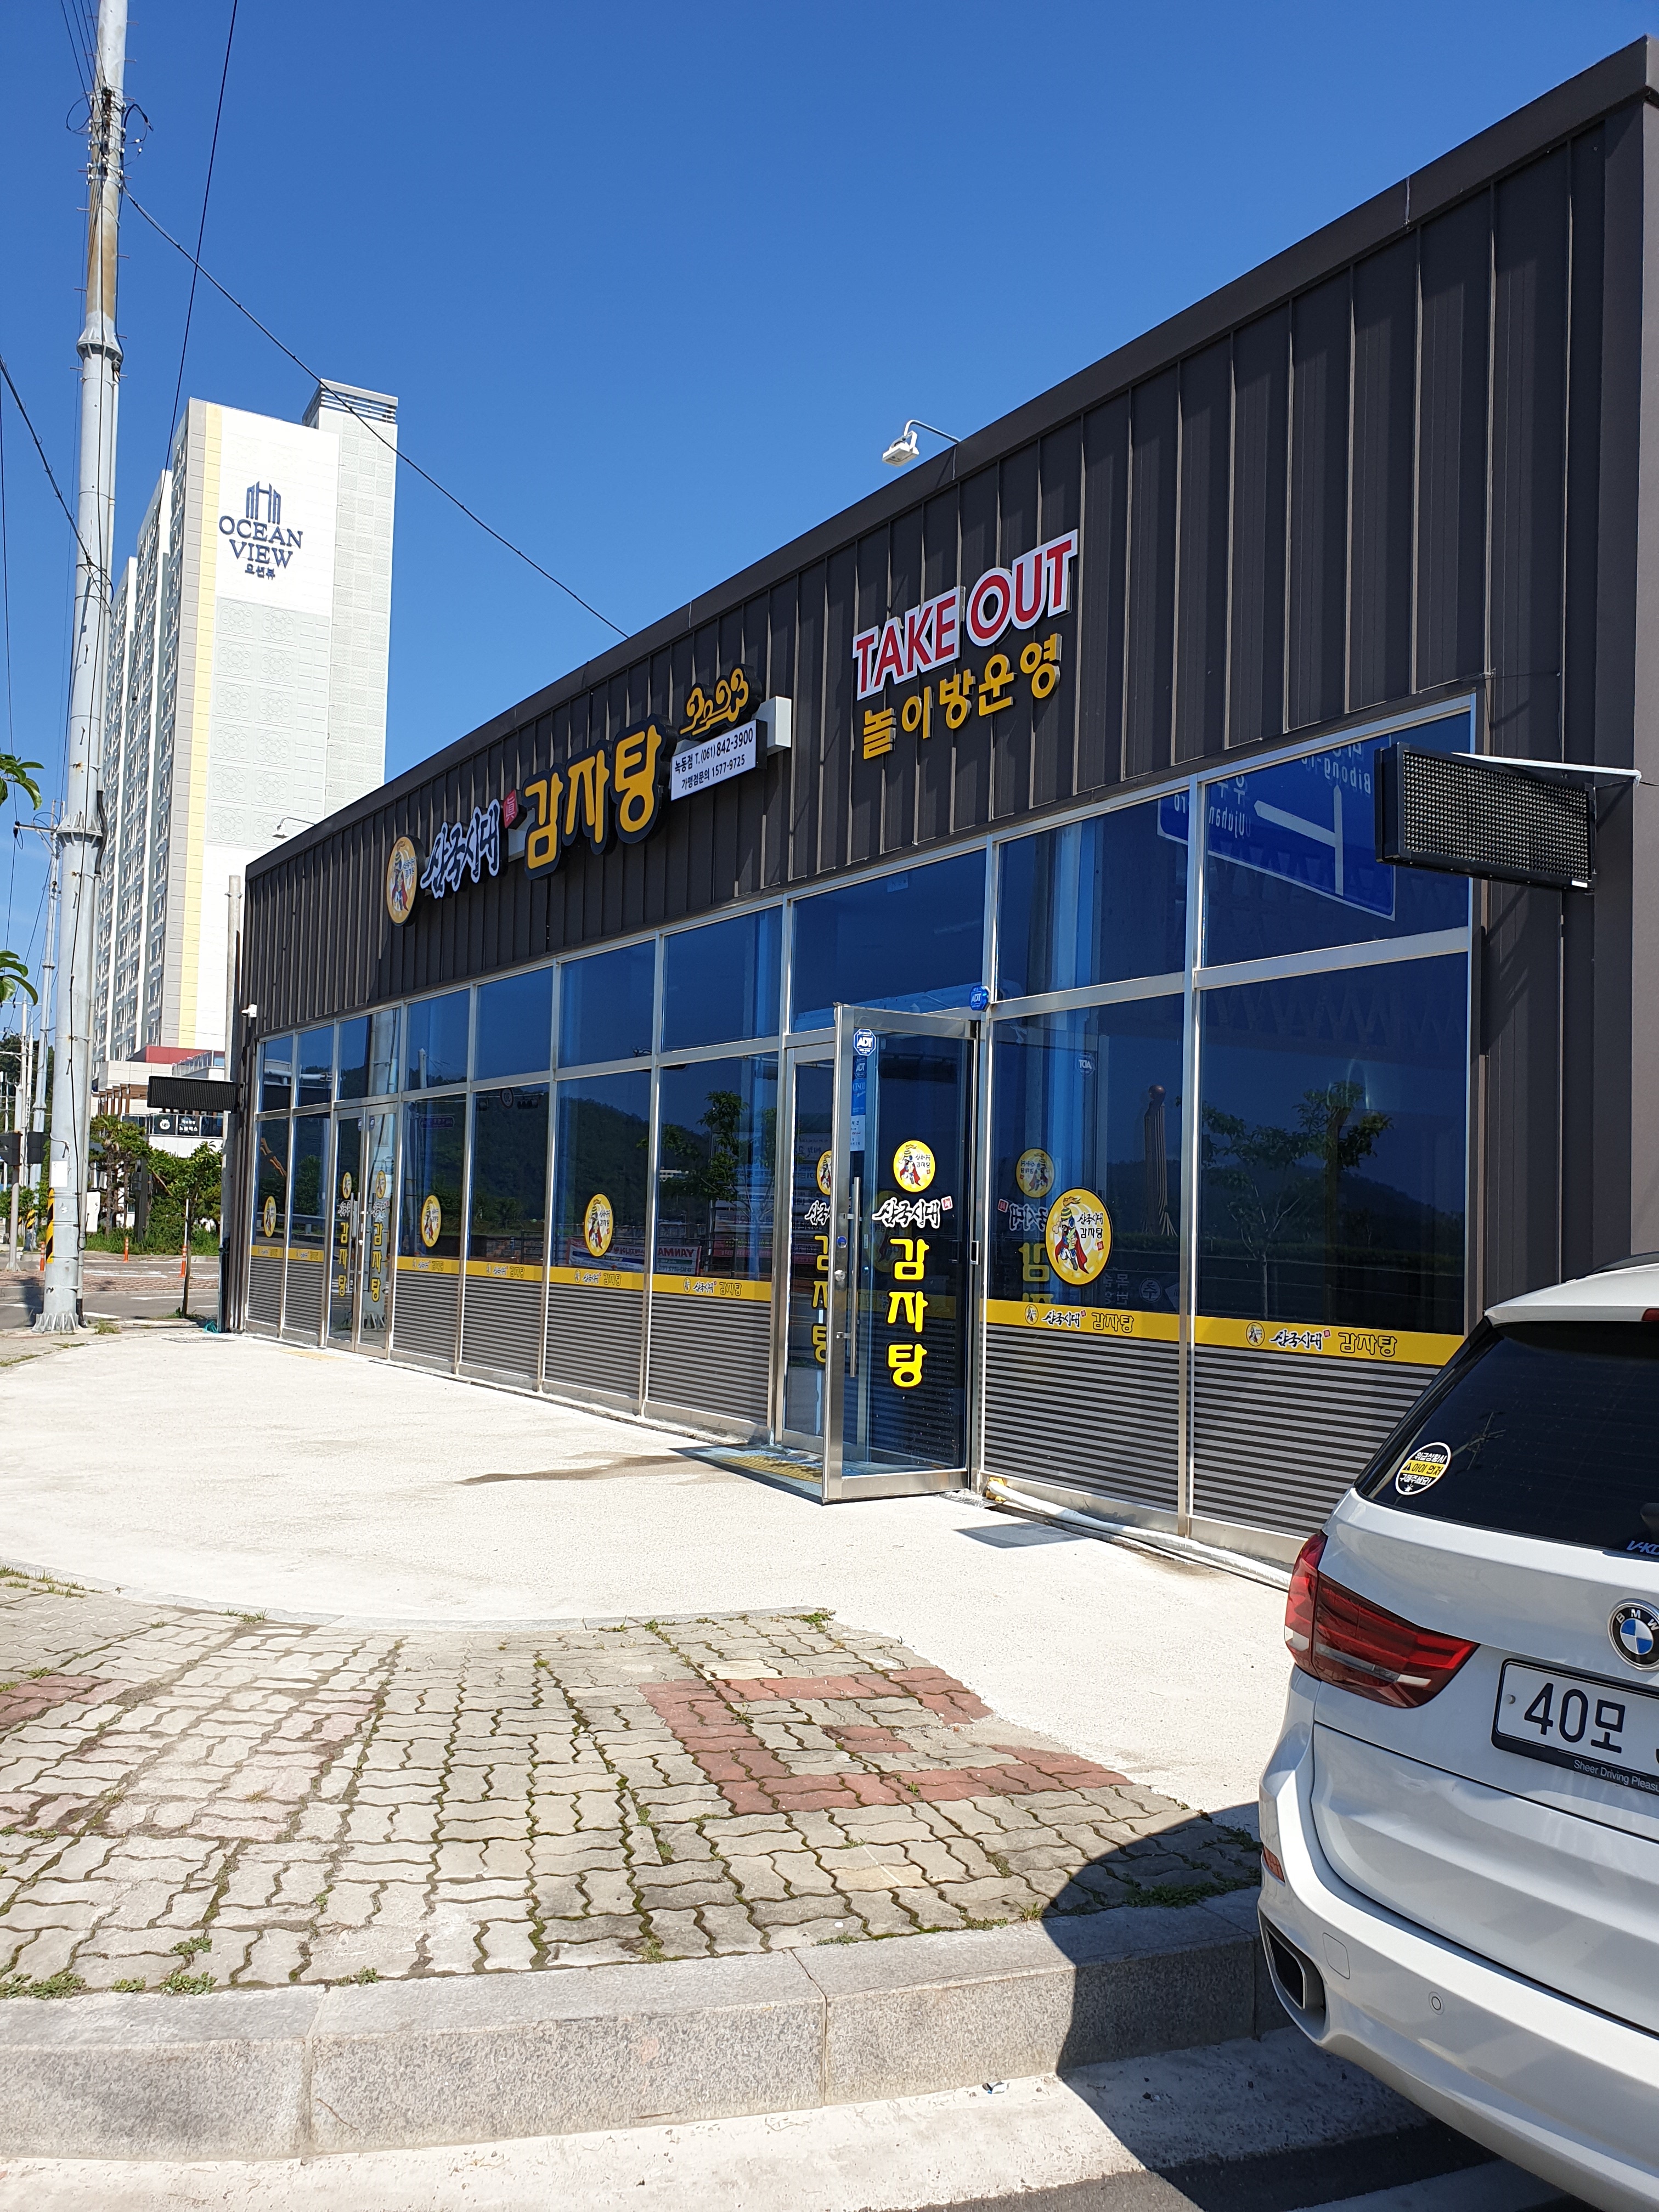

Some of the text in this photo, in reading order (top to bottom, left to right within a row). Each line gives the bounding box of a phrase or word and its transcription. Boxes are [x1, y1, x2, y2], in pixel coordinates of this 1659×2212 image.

[219, 515, 303, 549] OCEAN
[229, 539, 293, 569] VIEW
[245, 564, 275, 580] 오션뷰
[854, 532, 1076, 698] TAKE OUT
[675, 753, 693, 774] 녹동점
[681, 754, 745, 790] 가맹점문의 1577-9725
[524, 724, 662, 869] 감자탕
[971, 993, 981, 1003] ADT
[857, 1036, 873, 1047] ADT
[855, 1062, 866, 1073] ADT
[872, 1197, 940, 1228] 삼국시대
[1077, 1212, 1103, 1226] 삼국시대
[1080, 1227, 1103, 1239] 감자탕
[719, 1281, 742, 1296] 감자탕
[887, 1238, 930, 1387] 감자탕
[1042, 1310, 1135, 1333] 삼국시대 감자탕
[1270, 1329, 1398, 1358] 삼국시대 감자탕
[1414, 1452, 1447, 1464] 위급상황시
[1411, 1463, 1444, 1476] 아이 먼저
[1616, 1609, 1659, 1630] BMW
[1523, 1683, 1626, 1754] 40모
[1573, 1759, 1599, 1775] Sheer
[1600, 1767, 1629, 1786] Driving
